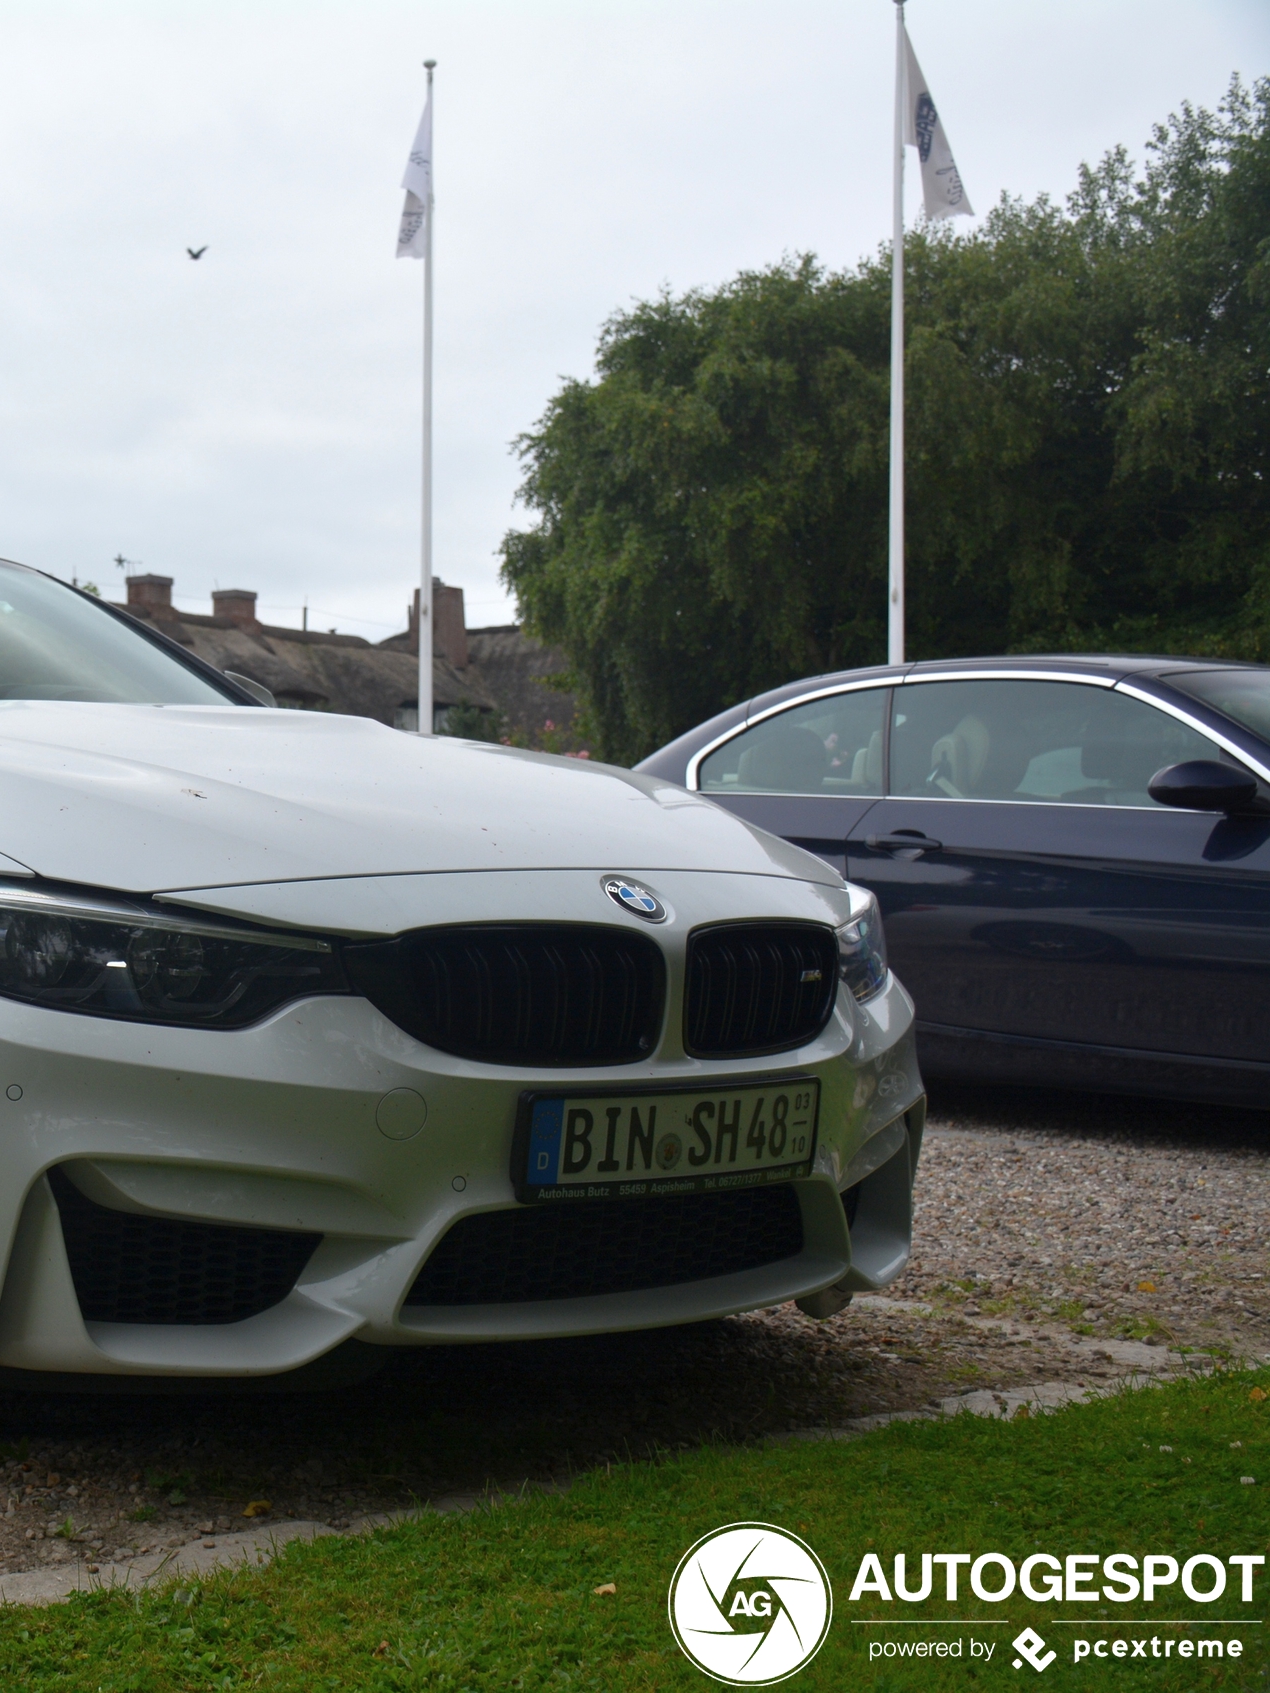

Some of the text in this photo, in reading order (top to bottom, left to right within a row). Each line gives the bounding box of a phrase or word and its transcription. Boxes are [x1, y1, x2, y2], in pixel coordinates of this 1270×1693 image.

[794, 1092, 811, 1111] 03
[562, 1105, 657, 1174] BIN
[791, 1136, 806, 1154] 10
[536, 1151, 550, 1170] D
[537, 1188, 586, 1200] Autohaus
[587, 1186, 610, 1198] Butz
[619, 1184, 646, 1195] 55459
[650, 1181, 695, 1194] Aspisheim
[704, 1178, 717, 1189] Tel.
[718, 1173, 762, 1187] 06727/1377
